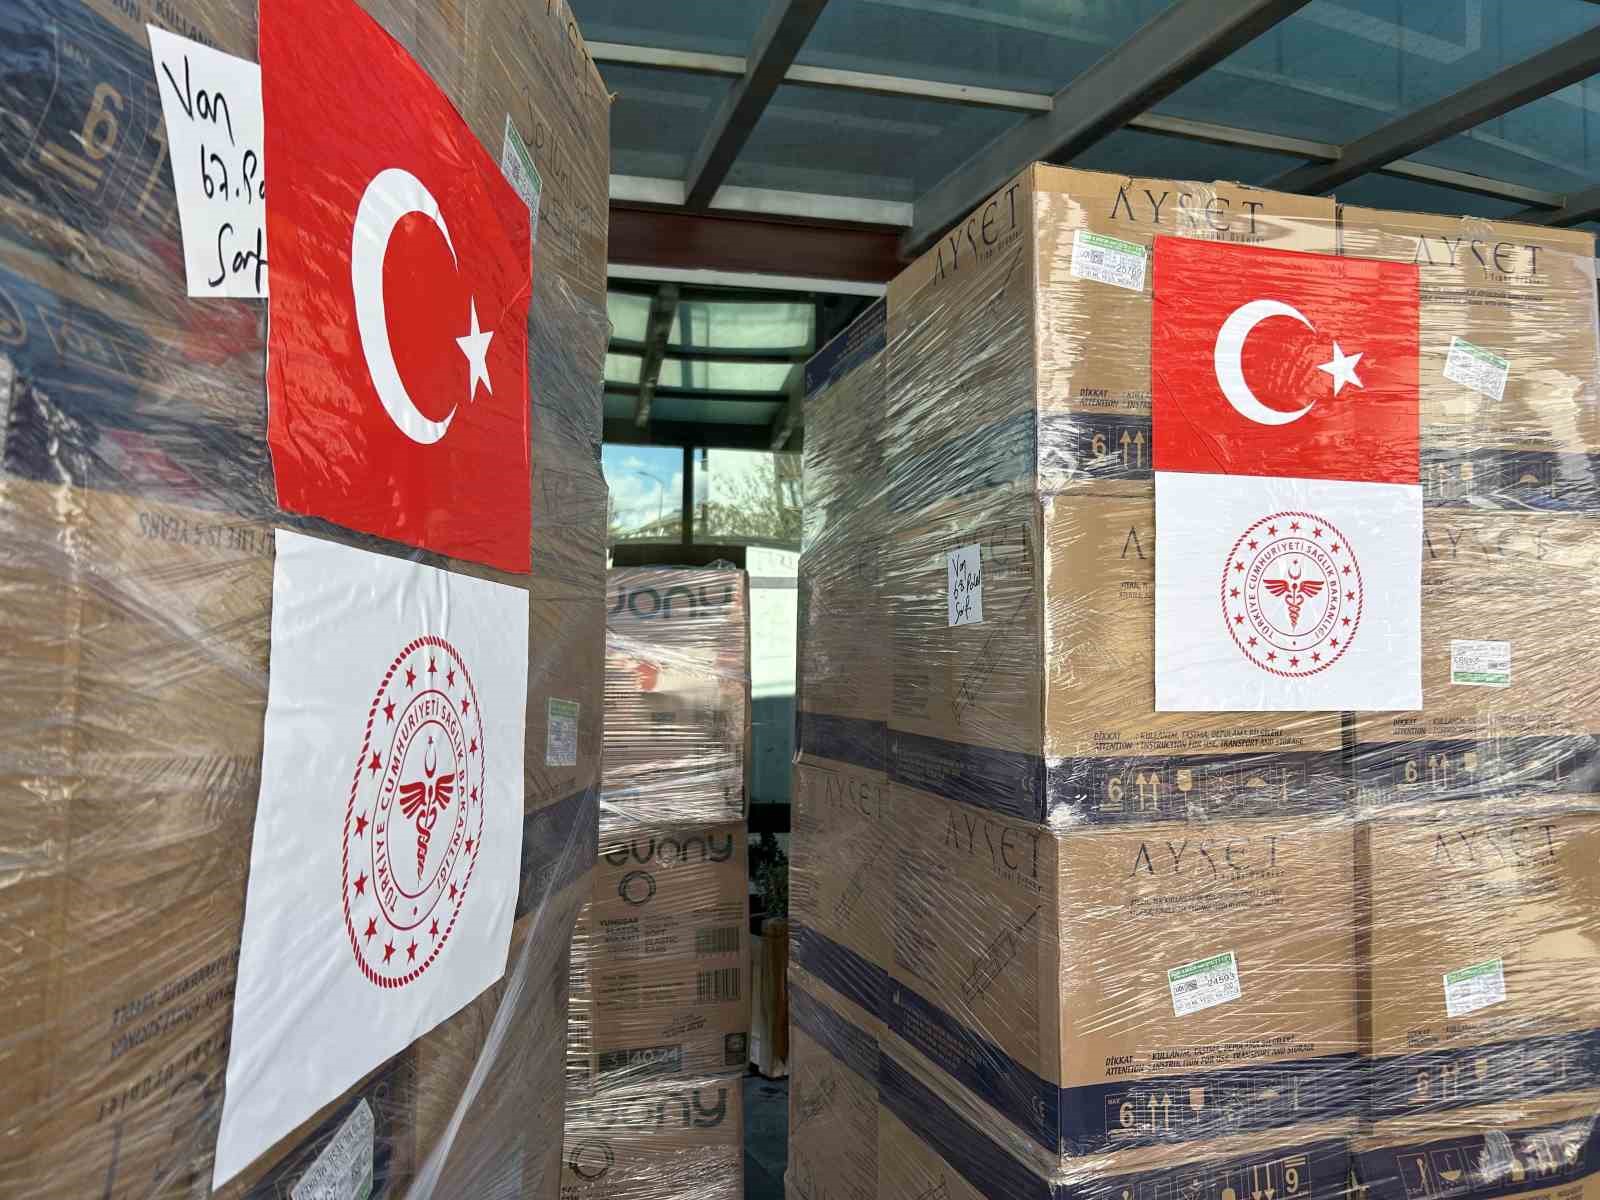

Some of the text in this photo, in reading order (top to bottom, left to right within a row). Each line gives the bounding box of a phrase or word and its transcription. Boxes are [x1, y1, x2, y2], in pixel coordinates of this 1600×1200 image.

[161, 54, 235, 146] Van
[81, 82, 125, 161] 6
[1109, 186, 1265, 234] AYSET
[932, 183, 1020, 287] AYSET
[1414, 234, 1543, 276] AYSET
[1091, 432, 1107, 458] 6
[1108, 777, 1122, 801] 6
[1404, 760, 1418, 784] 6
[376, 699, 466, 912] TÜRKİYE CUMHURİYETİ SAĞLIK BAKANLIĞI
[604, 832, 733, 867] evony
[1119, 1101, 1135, 1128] 6
